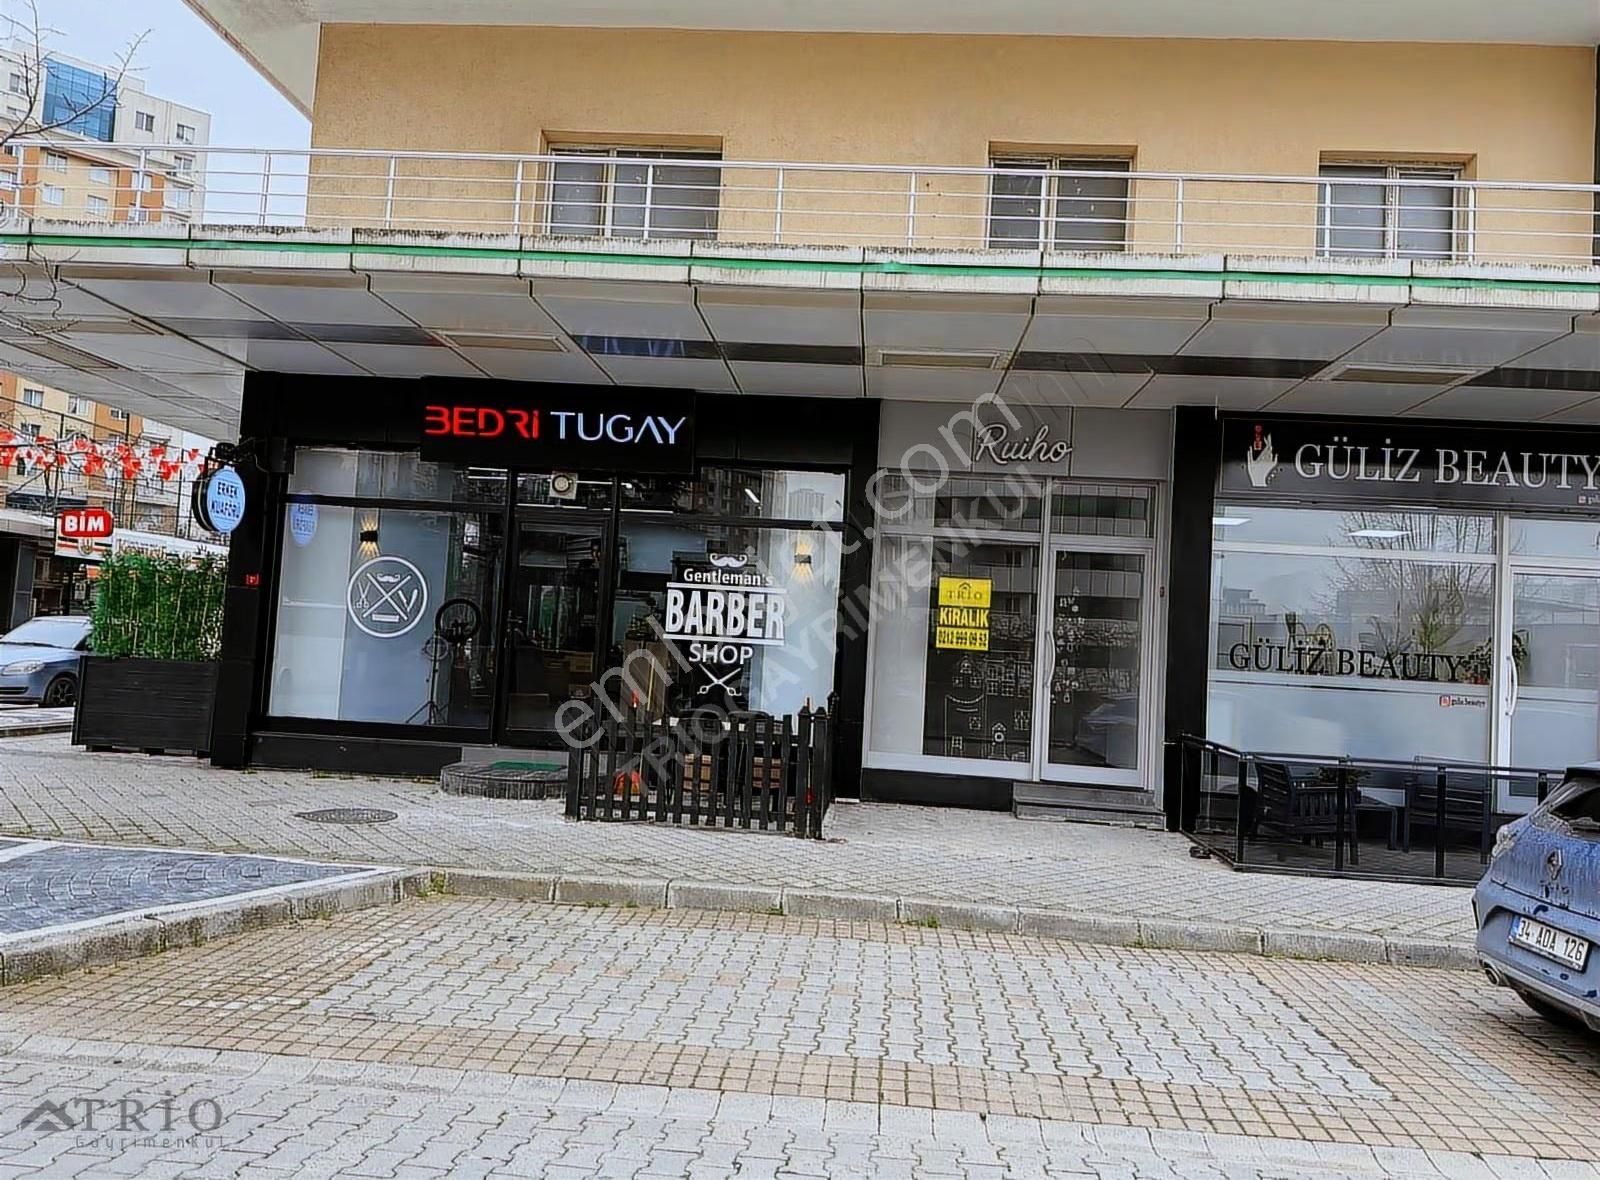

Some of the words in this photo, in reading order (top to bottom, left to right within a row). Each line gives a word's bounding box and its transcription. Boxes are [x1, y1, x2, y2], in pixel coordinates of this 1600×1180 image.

[549, 410, 687, 445] TUGAY
[975, 423, 1073, 465] Ruiho
[1294, 435, 1422, 484] GÜLİZ
[64, 510, 106, 533] BİM
[683, 567, 776, 587] Gentleman's
[665, 588, 786, 640] BARBER
[688, 643, 754, 665] SHOP
[1336, 648, 1466, 682] BEAUTY
[1518, 919, 1531, 941] 34
[1563, 936, 1586, 962] 126
